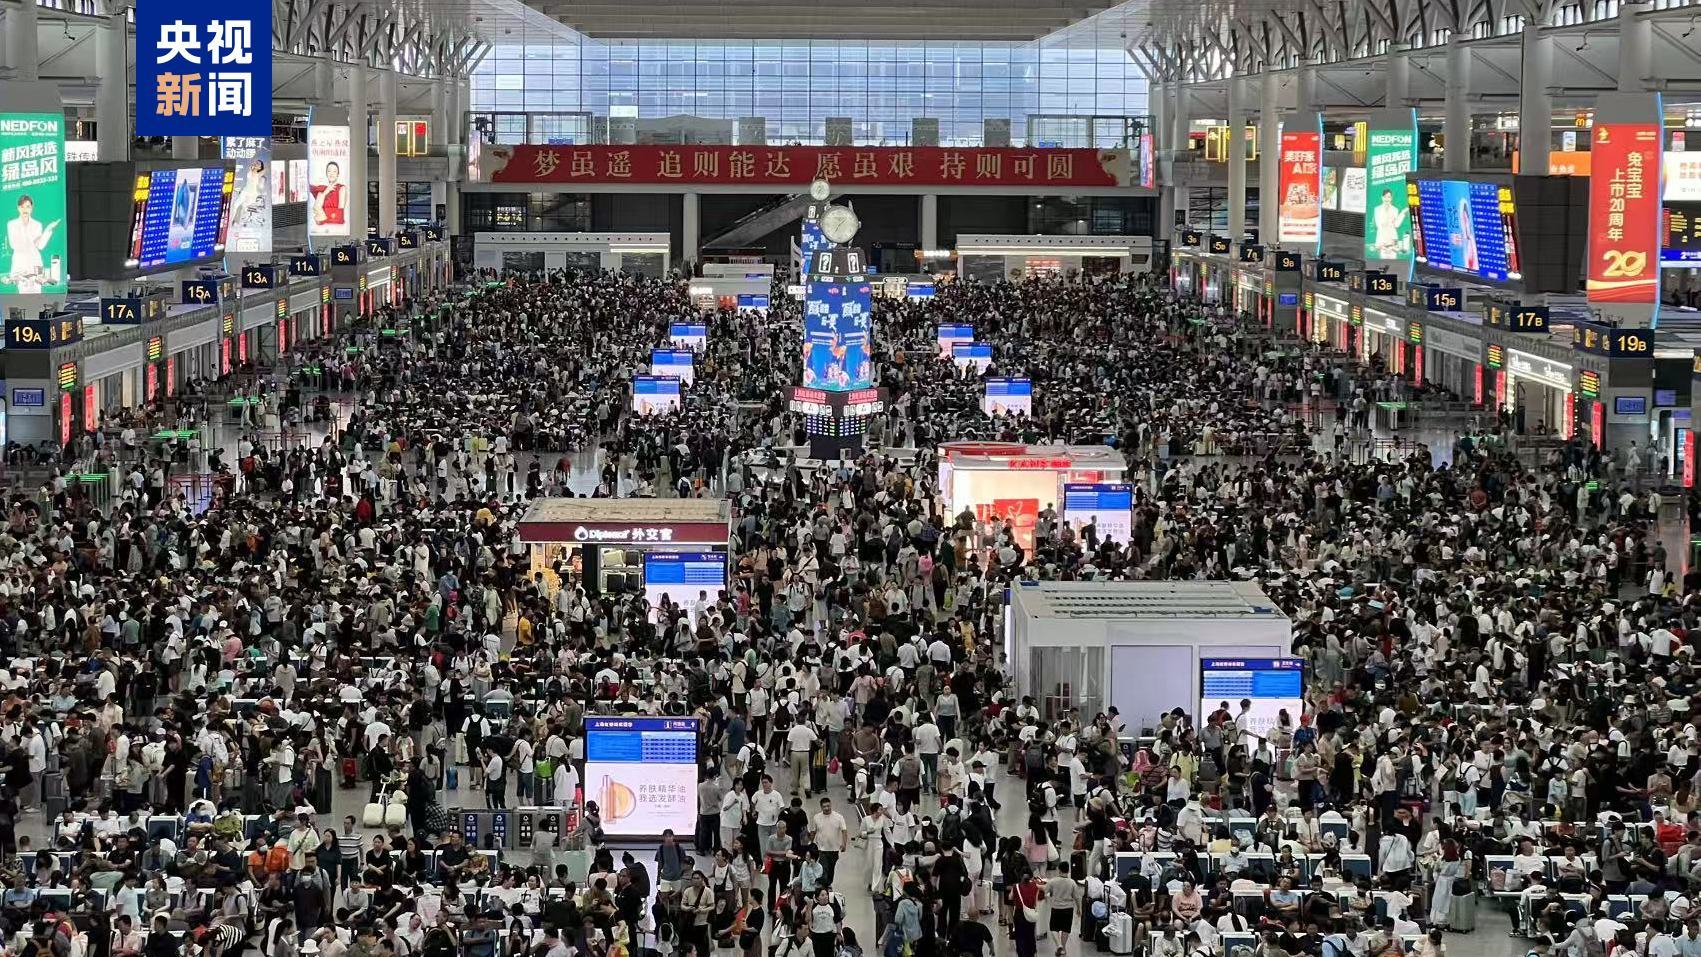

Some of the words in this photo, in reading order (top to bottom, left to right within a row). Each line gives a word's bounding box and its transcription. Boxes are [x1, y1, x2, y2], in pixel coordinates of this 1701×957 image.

[1, 120, 58, 131] NEDFON
[226, 136, 265, 148] 累了麻了
[1372, 135, 1411, 144] NEDFON
[533, 150, 632, 177] 梦虽遥
[657, 150, 791, 178] 追则能达
[816, 150, 914, 179] 愿虽艰
[940, 151, 1074, 179] 持则可圆
[1626, 151, 1643, 199] 兔宝宝
[1607, 168, 1625, 241] 上市20周年
[401, 236, 412, 246] 5A
[427, 230, 437, 239] 3A
[371, 243, 382, 253] 7A
[337, 252, 349, 262] 9A
[1282, 257, 1295, 268] 9B
[1602, 249, 1647, 277] 20
[295, 260, 314, 272] 11A
[246, 271, 268, 284] 13A
[1321, 267, 1340, 279] 11B
[1371, 278, 1393, 291] 13B
[188, 286, 211, 300] 15A
[1433, 293, 1457, 307] 15B
[107, 304, 135, 319] 17A
[1516, 312, 1544, 327] 17B
[13, 326, 42, 343] 19A
[1617, 335, 1647, 352] 19B
